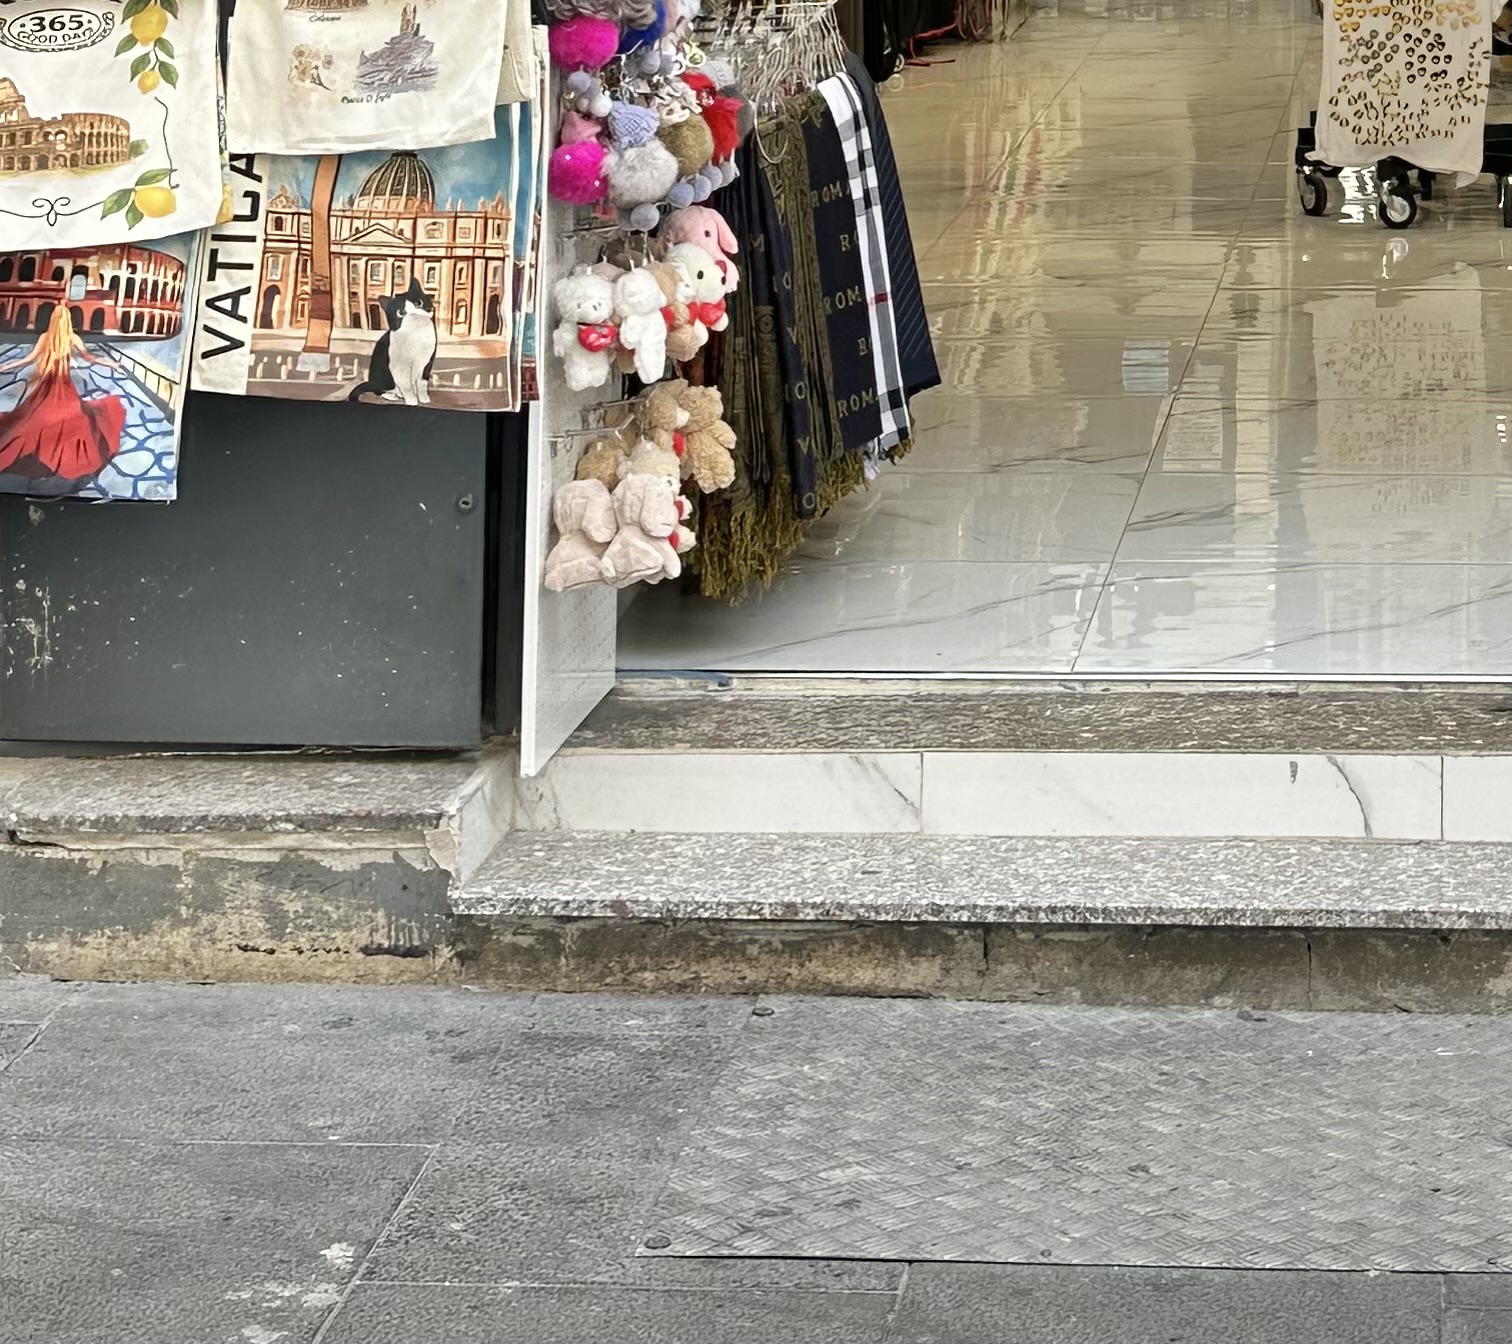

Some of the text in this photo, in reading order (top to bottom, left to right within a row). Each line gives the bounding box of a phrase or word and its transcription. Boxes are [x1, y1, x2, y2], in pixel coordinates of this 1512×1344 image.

[30, 14, 83, 32] 365
[201, 153, 262, 360] VATICA
[823, 285, 862, 314] ROM
